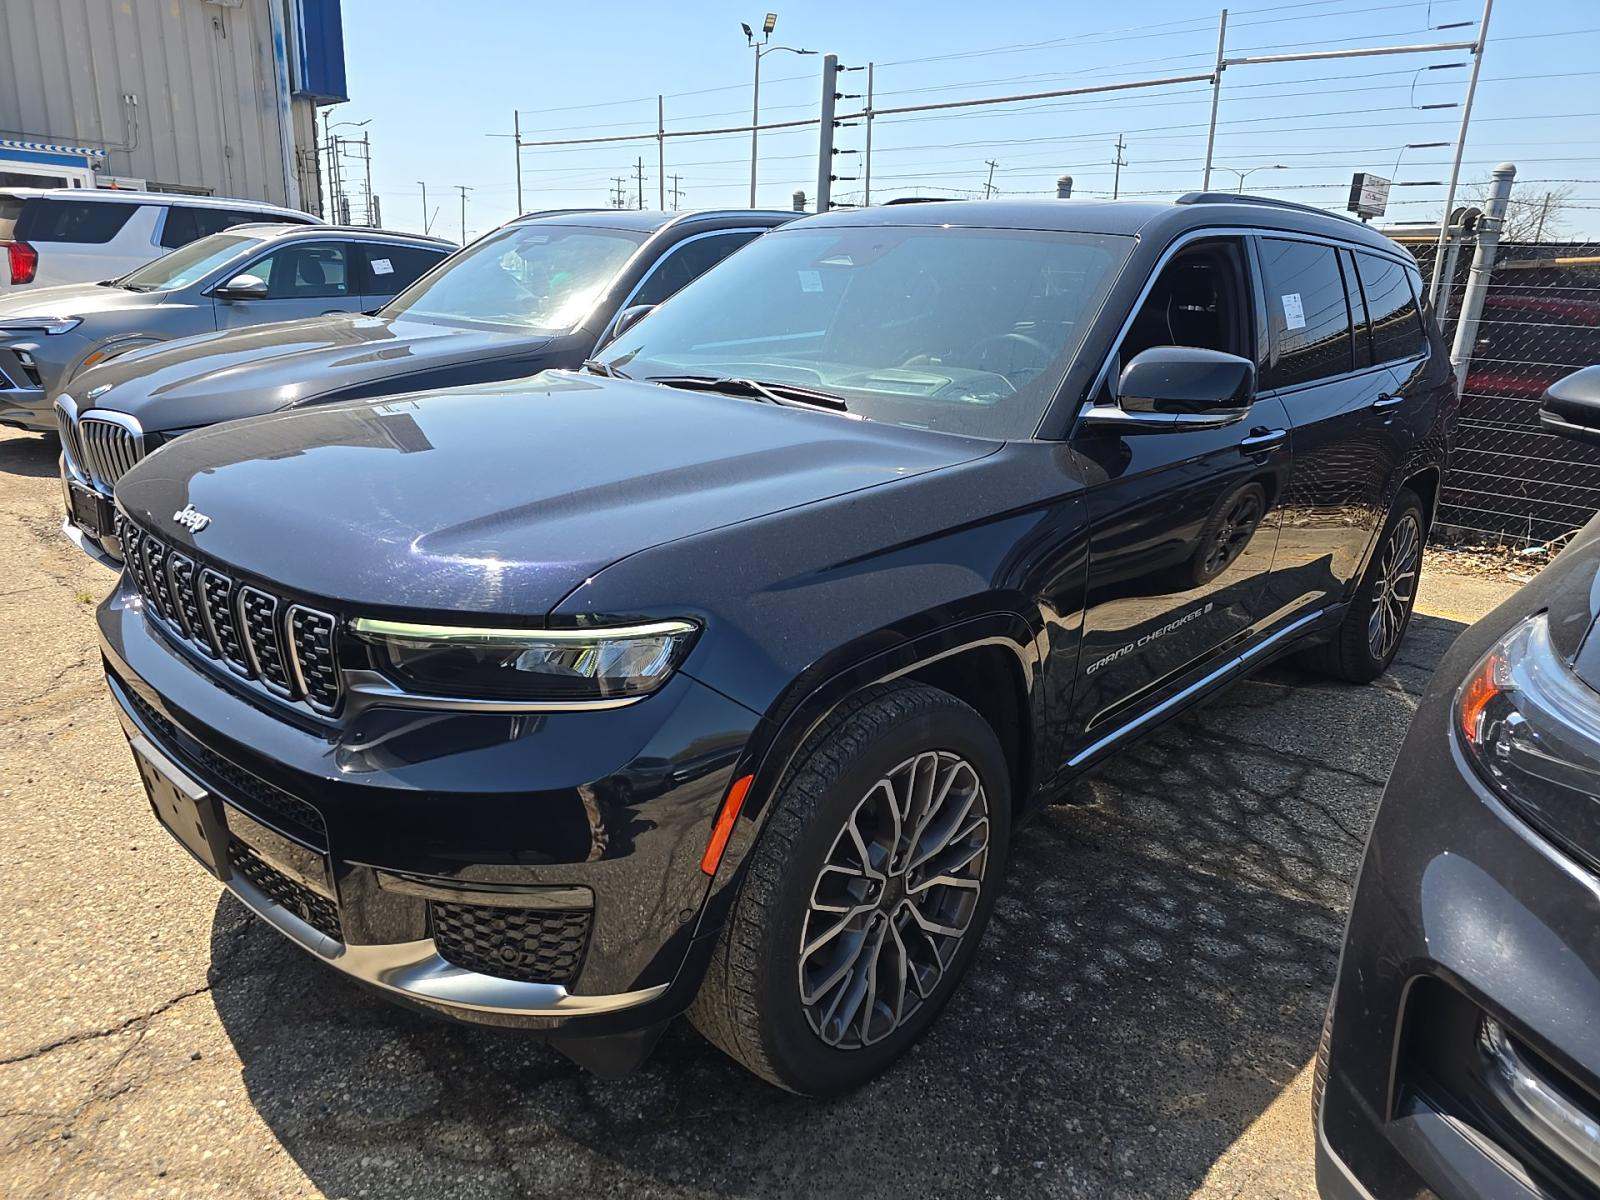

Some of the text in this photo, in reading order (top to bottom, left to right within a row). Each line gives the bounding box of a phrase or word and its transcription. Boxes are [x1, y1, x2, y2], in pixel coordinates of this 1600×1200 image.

[173, 504, 212, 534] Jeep
[1086, 608, 1202, 675] GRAND CHEROKEE
